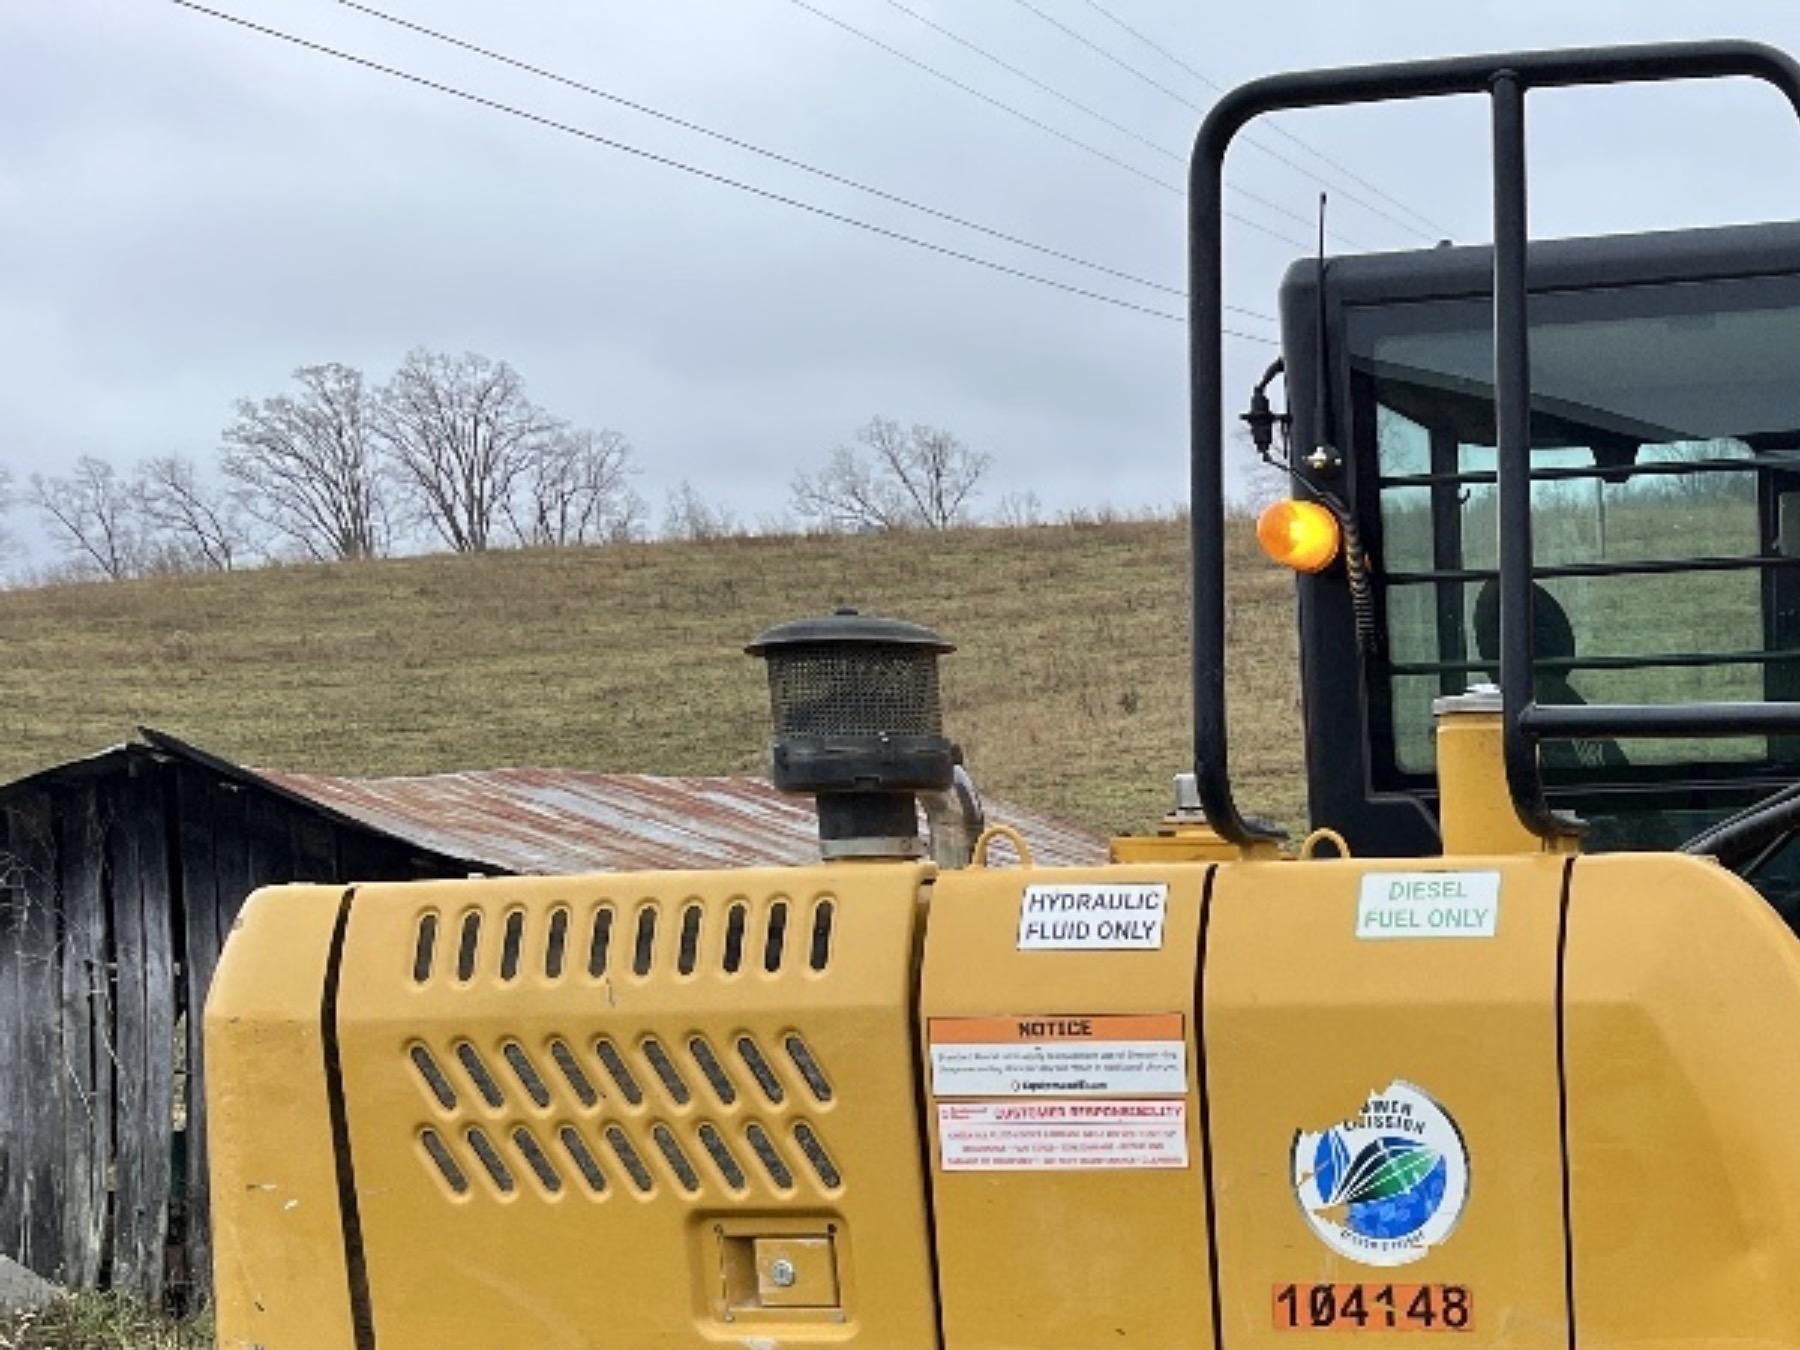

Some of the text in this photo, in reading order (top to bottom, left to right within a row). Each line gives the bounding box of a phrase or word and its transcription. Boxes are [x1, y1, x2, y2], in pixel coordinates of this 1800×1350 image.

[1388, 881, 1468, 901] DIESEL
[1028, 892, 1160, 912] HYDRAULIC
[1364, 908, 1489, 928] FUEL ONLY
[1026, 920, 1156, 940] FLUID ONLY
[1018, 1020, 1093, 1037] NOTICE
[1277, 1283, 1469, 1328] 104148
